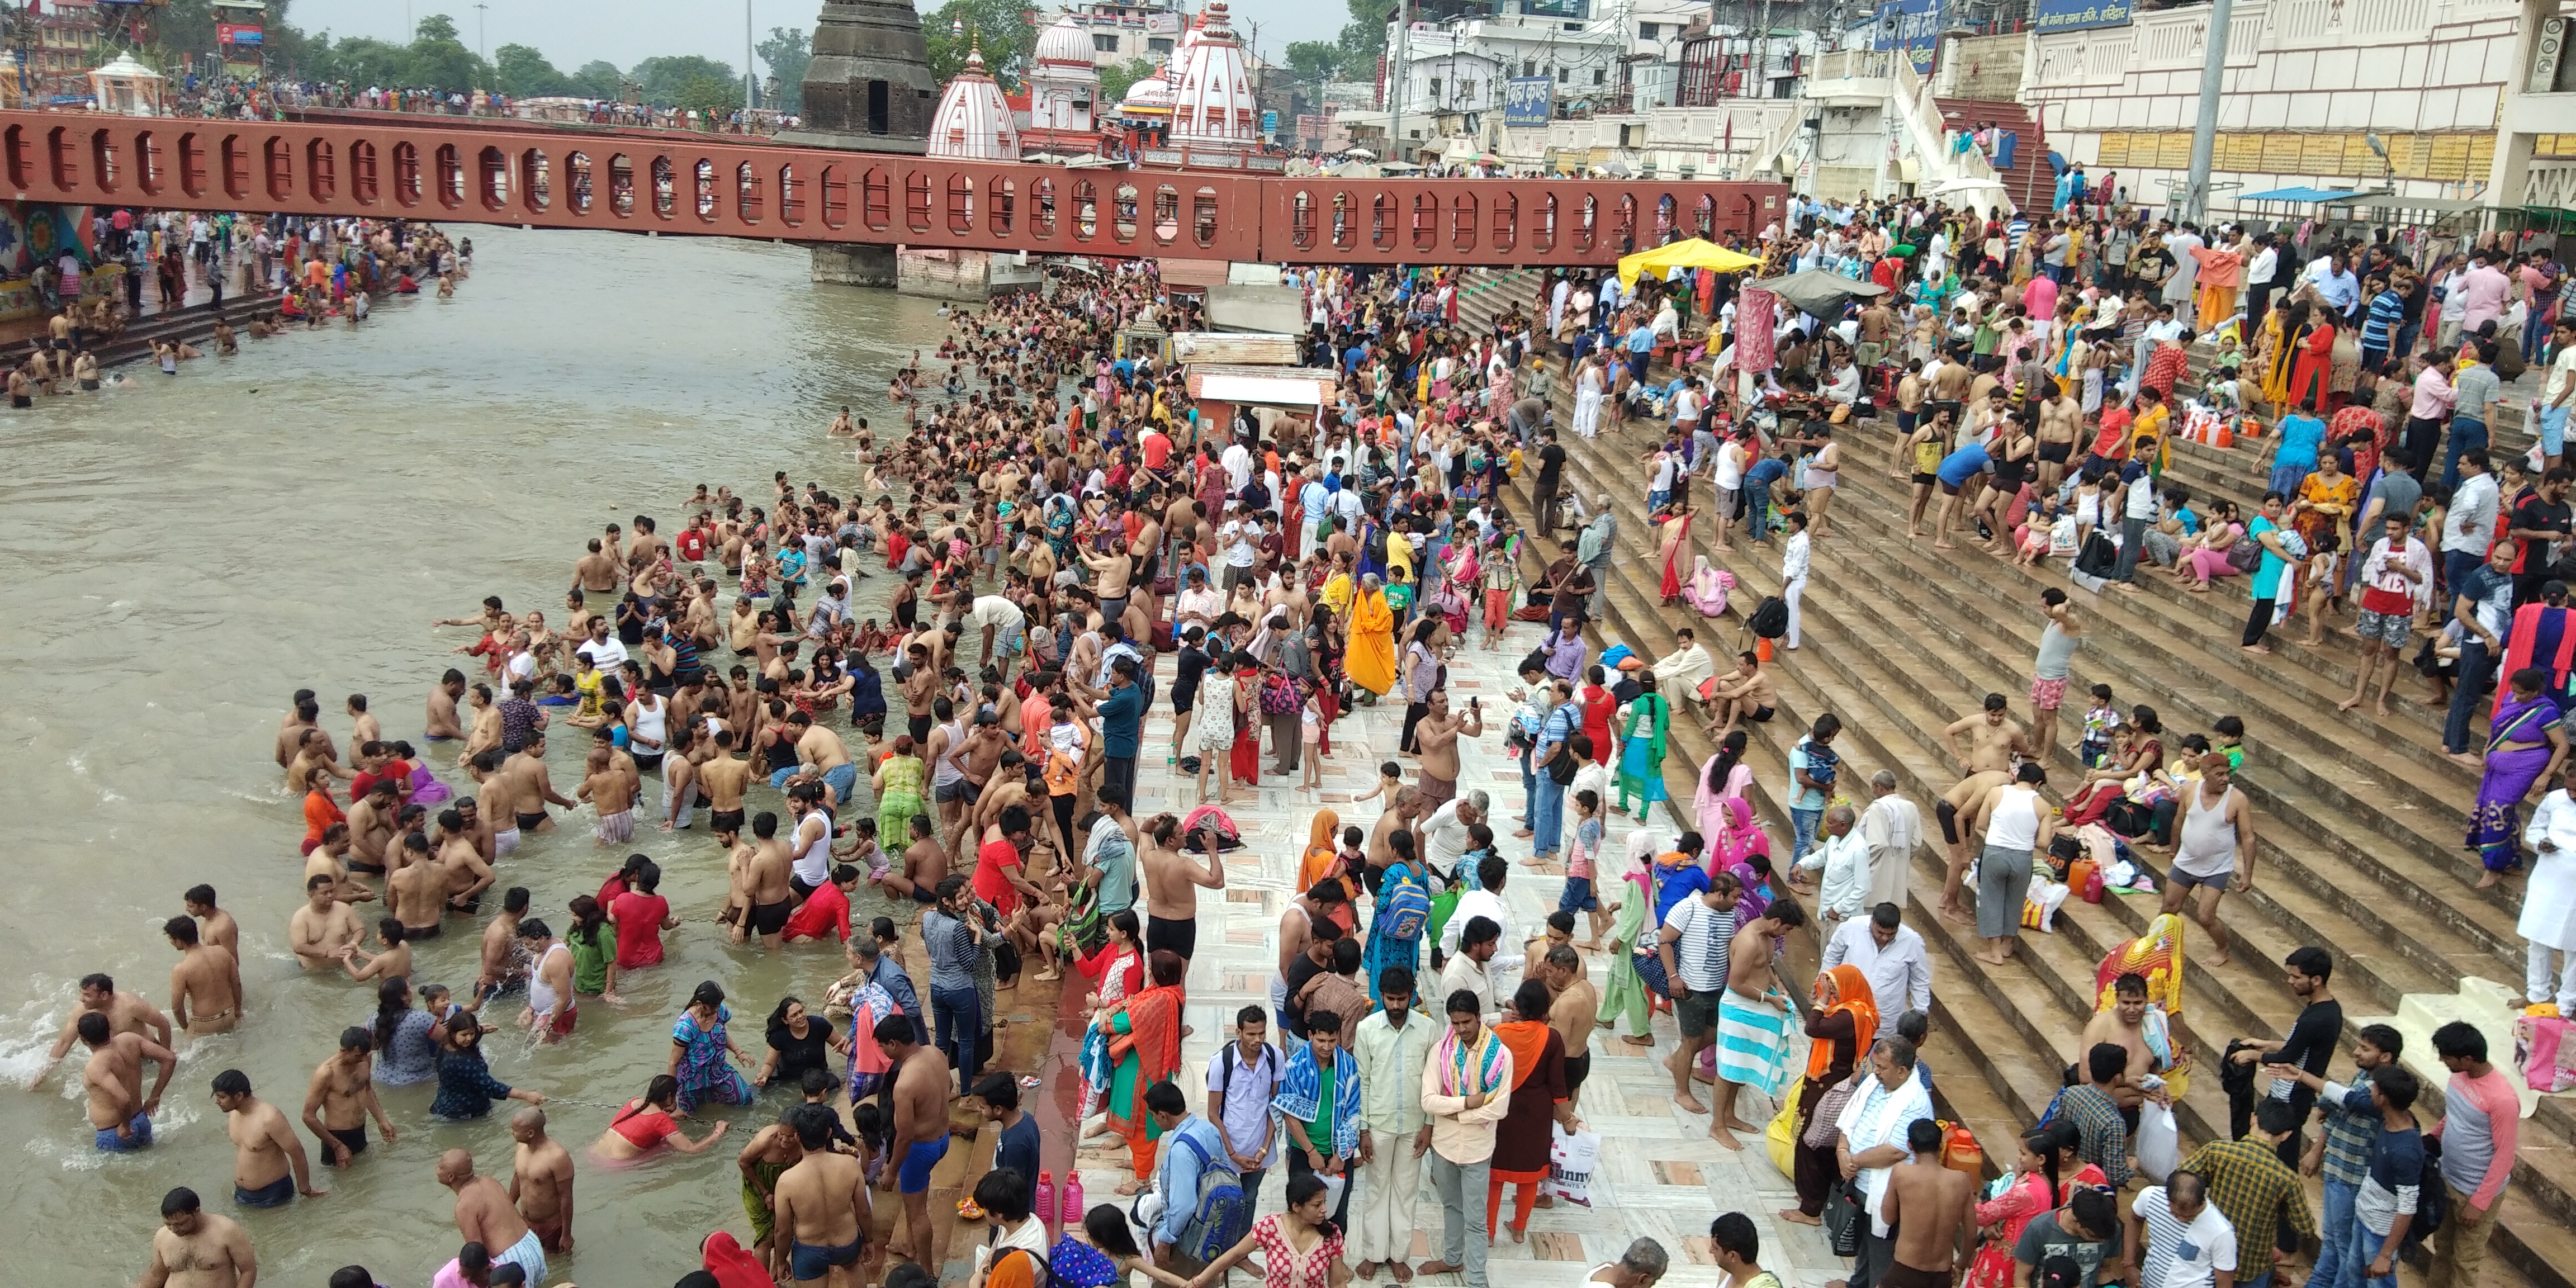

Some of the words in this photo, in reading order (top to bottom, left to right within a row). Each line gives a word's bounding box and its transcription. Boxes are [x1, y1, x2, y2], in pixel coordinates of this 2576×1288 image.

[2039, 12, 2049, 27] श्री
[2049, 11, 2065, 26] गंगा
[2065, 12, 2082, 25] सभा
[2100, 4, 2127, 22] हरिद्वार
[1508, 81, 1527, 108] ब्रह्म
[1524, 80, 1549, 112] कुण्ड
